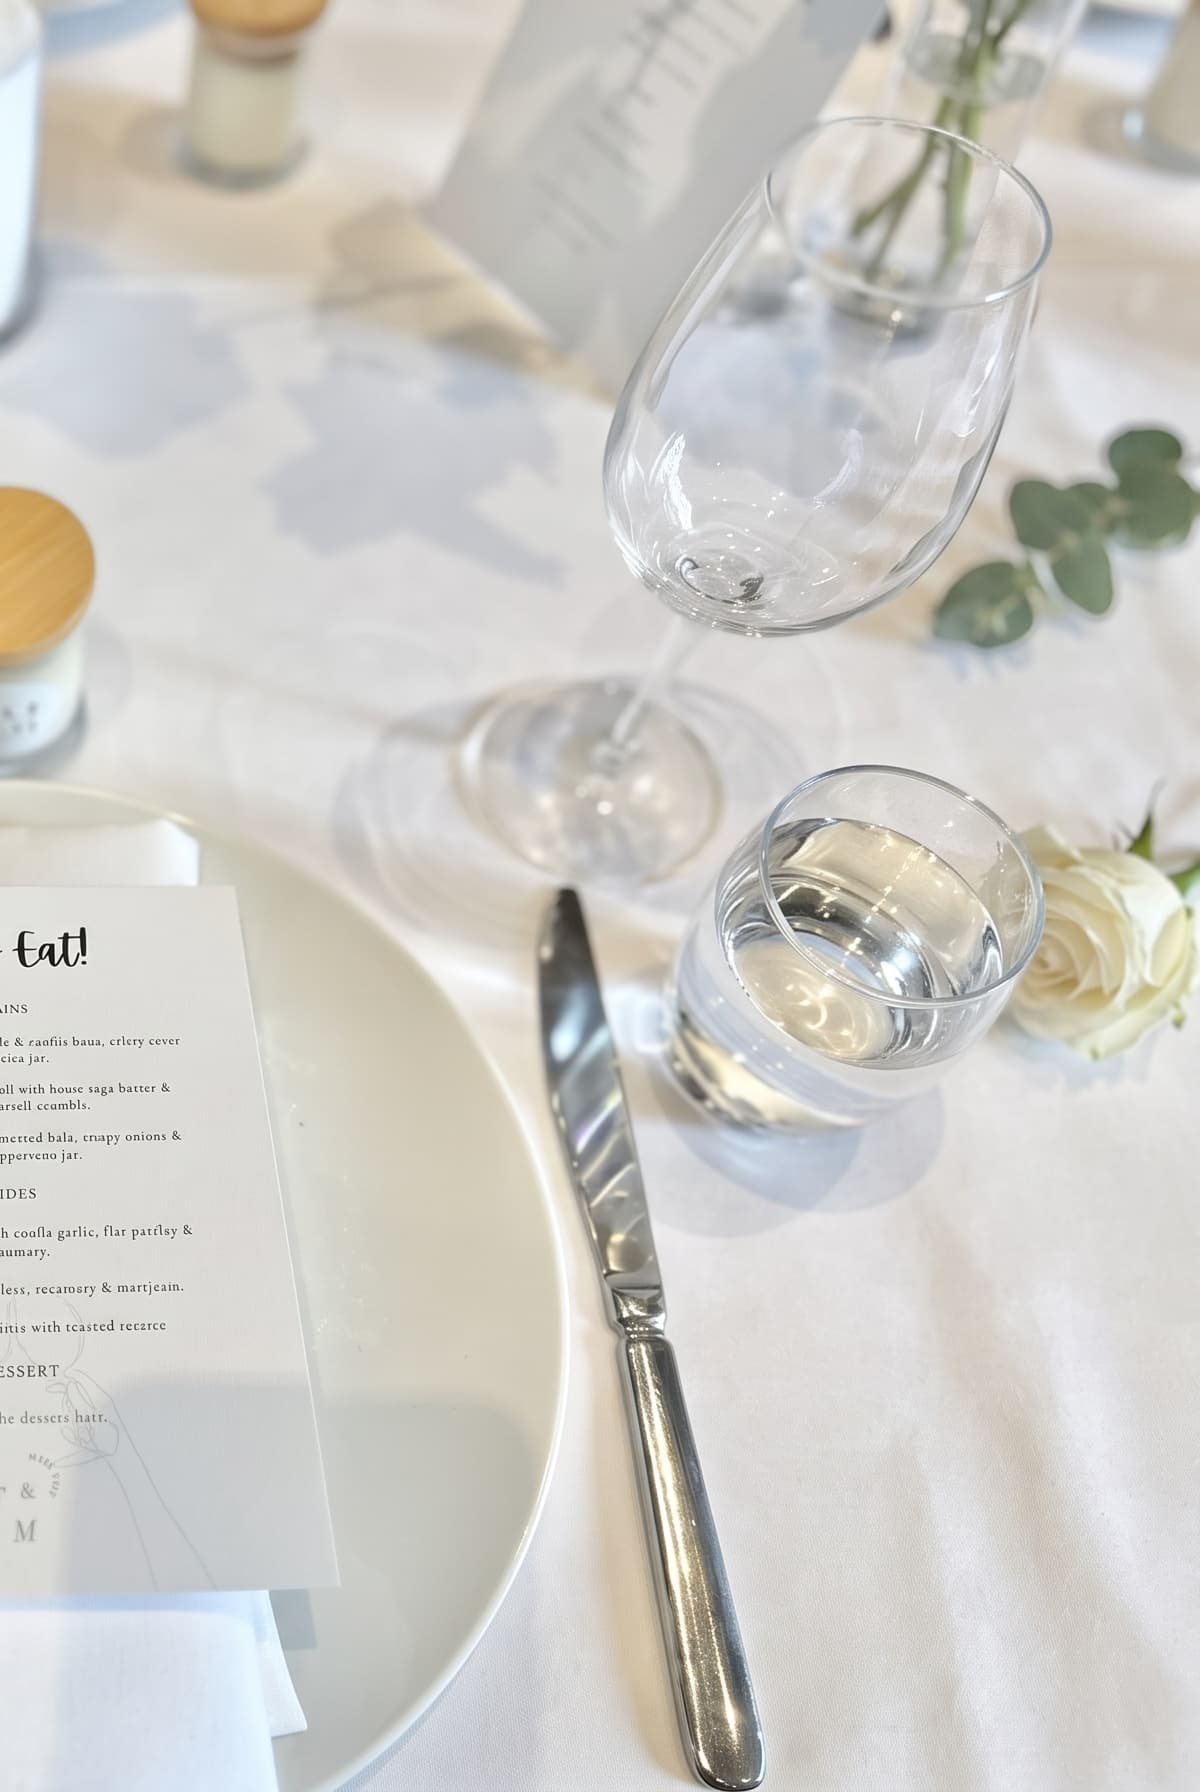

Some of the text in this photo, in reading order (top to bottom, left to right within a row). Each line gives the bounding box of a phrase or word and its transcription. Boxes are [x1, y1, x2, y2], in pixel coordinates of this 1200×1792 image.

[13, 927, 87, 968] Eat!
[14, 1037, 24, 1047] &
[28, 1053, 49, 1066] jar.
[19, 1084, 44, 1094] with
[49, 1084, 83, 1093] house
[88, 1086, 114, 1096] saga
[161, 1082, 171, 1092] &
[48, 1132, 78, 1143] bala,
[125, 1131, 167, 1141] onions
[172, 1130, 182, 1141] &
[58, 1226, 99, 1241] garlic,
[183, 1224, 193, 1235] &
[102, 1282, 112, 1293] &
[31, 1321, 61, 1333] with
[21, 1482, 36, 1499] &
[14, 1520, 37, 1543] M
